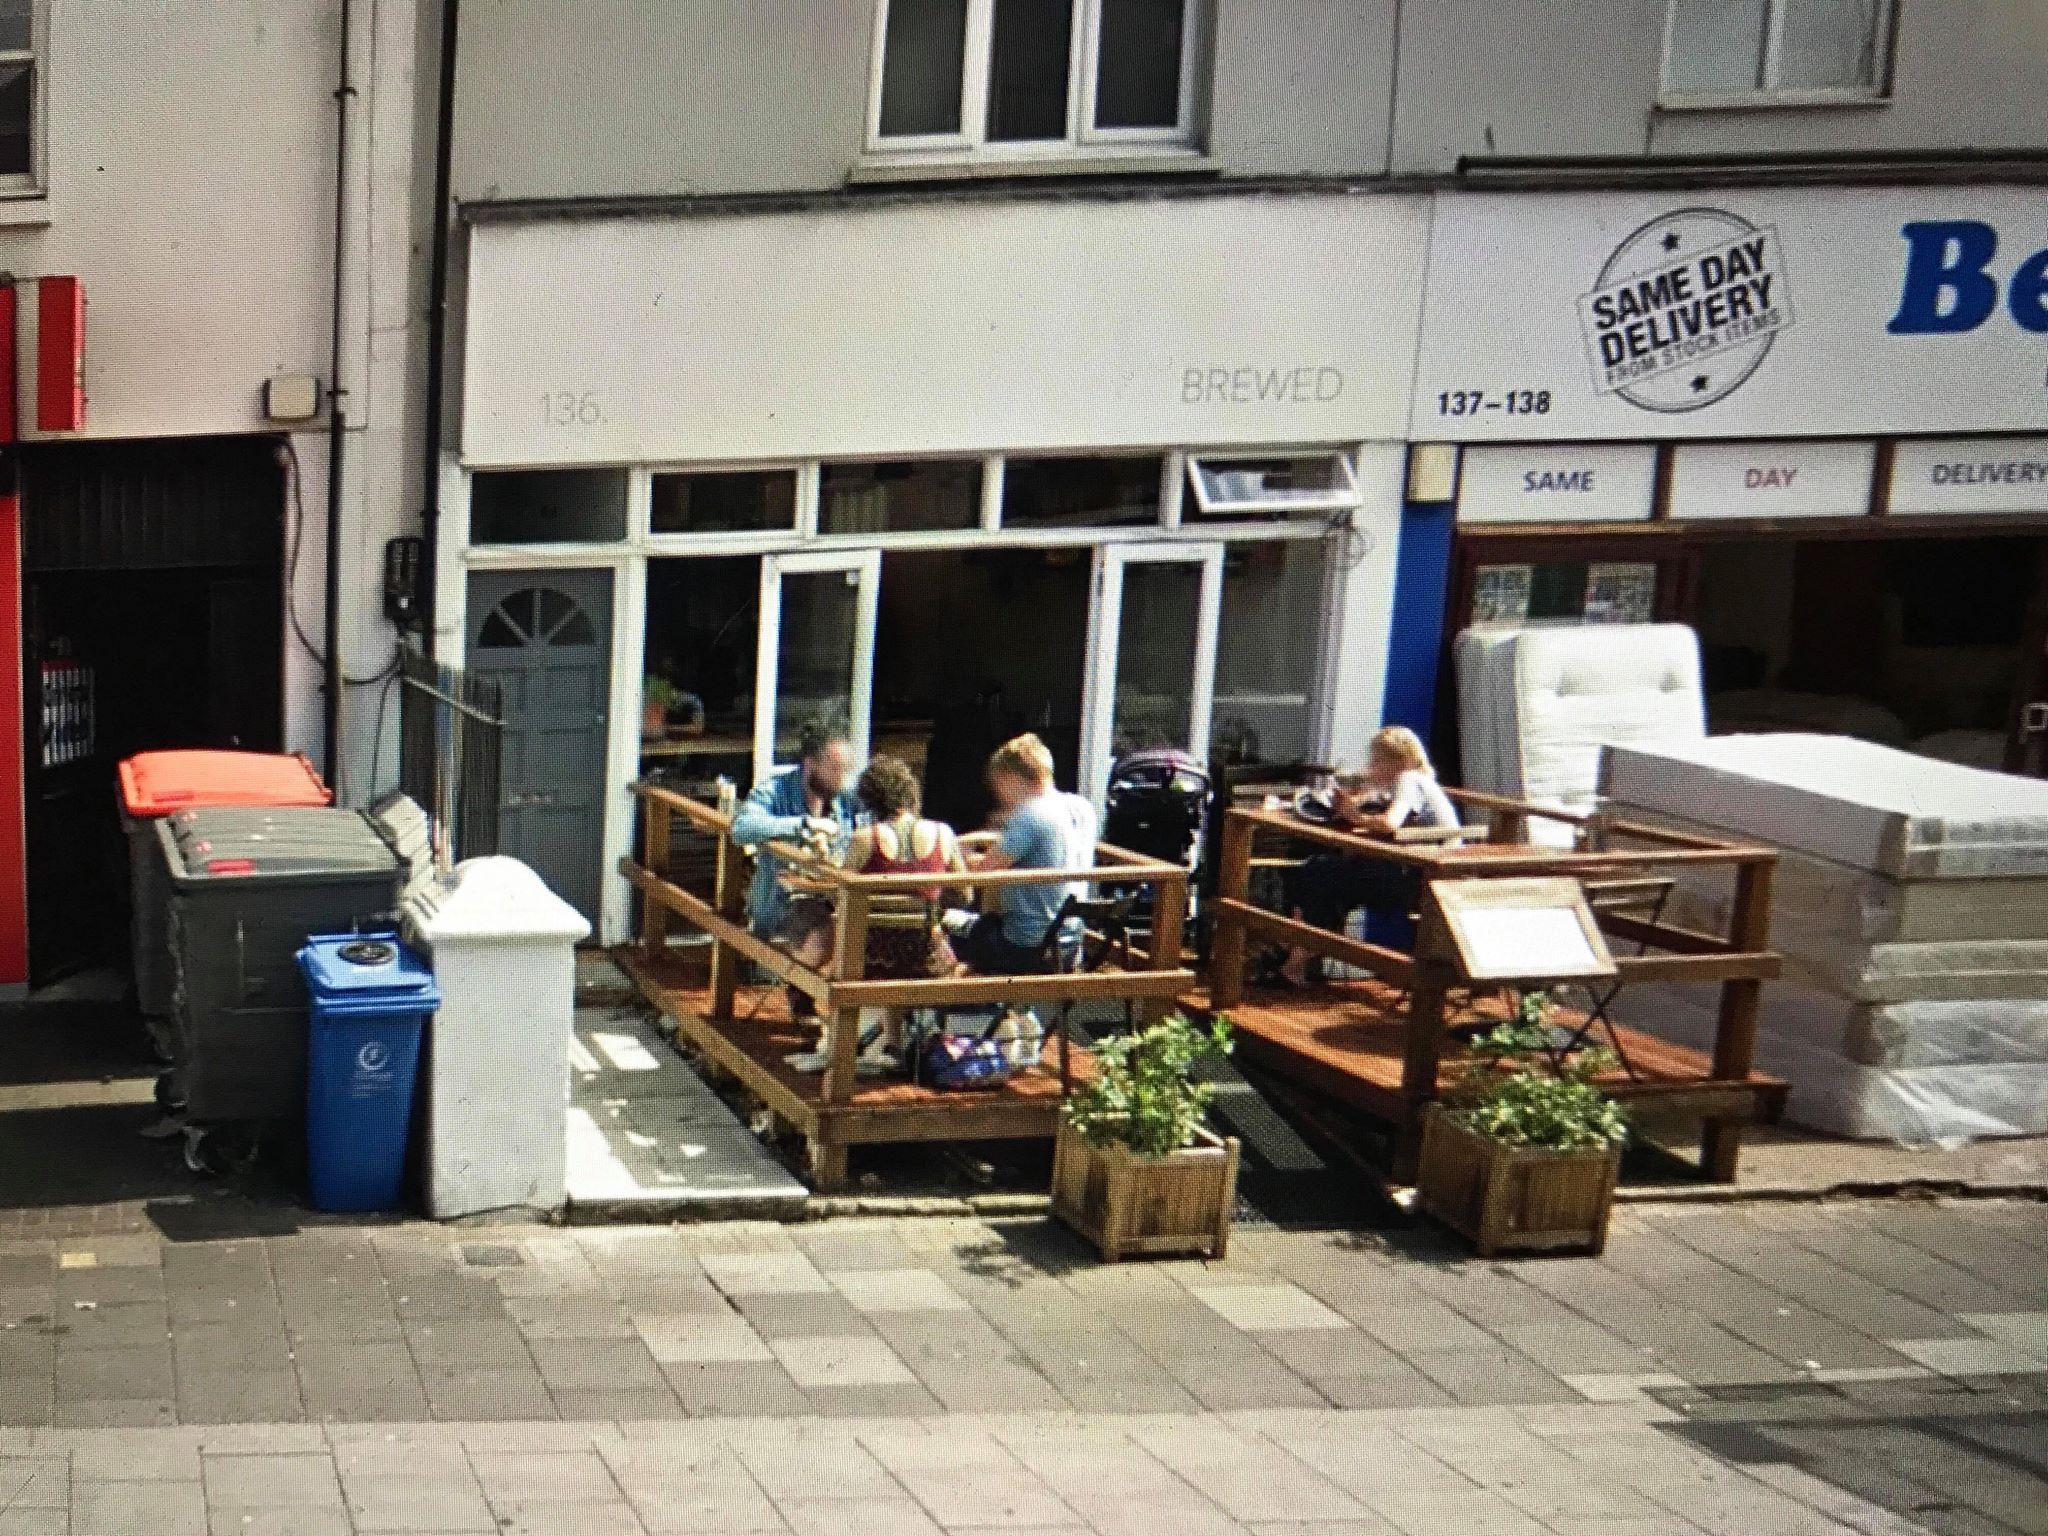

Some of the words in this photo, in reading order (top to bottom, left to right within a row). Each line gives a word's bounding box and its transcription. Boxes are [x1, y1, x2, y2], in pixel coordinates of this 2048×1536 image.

[1592, 266, 1693, 329] SAME
[1700, 237, 1765, 291] DAY
[1600, 273, 1772, 368] DELIVERY
[1181, 366, 1344, 402] BREWED
[1438, 390, 1550, 416] 137-138
[1523, 470, 1594, 493] SAME
[1744, 467, 1797, 489] DAY
[1932, 462, 2048, 485] DELIVERY
